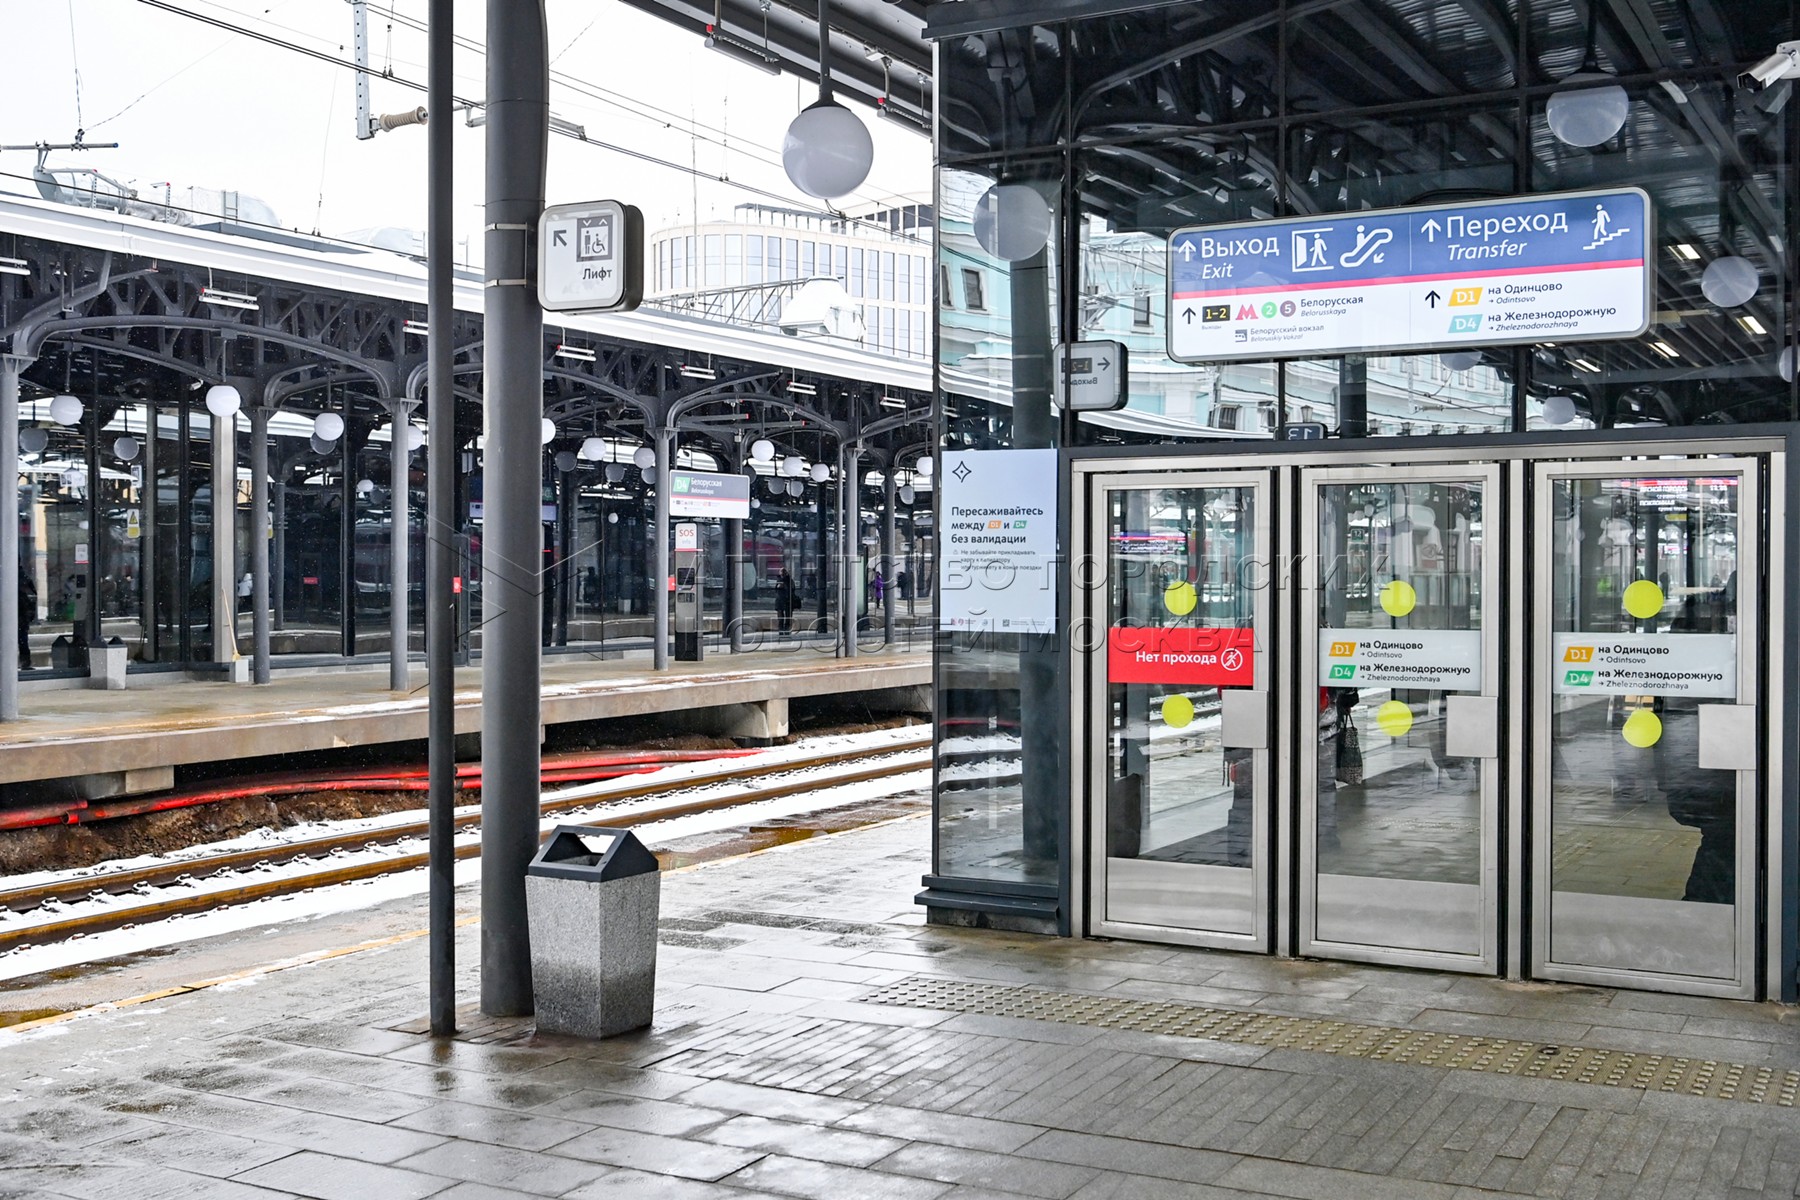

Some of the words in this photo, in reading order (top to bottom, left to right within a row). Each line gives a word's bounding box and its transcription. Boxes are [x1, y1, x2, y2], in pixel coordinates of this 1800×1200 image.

[1447, 212, 1569, 241] Переход
[1201, 237, 1279, 259] Выход
[1448, 239, 1527, 261] Transfer
[583, 267, 612, 281] Лифт
[1202, 263, 1233, 280] Exit
[1488, 286, 1501, 295] на
[1504, 282, 1563, 295] Одинцово
[1456, 290, 1475, 303] D1
[1496, 295, 1535, 304] Odintsovo
[1300, 296, 1364, 309] Белорусская
[1300, 307, 1347, 318] Belorusskaya
[1488, 314, 1501, 322] на
[1504, 306, 1616, 322] Железнодорожную
[1455, 318, 1476, 330] D4
[1496, 320, 1578, 332] Zheleznodorozhnaya
[1250, 327, 1297, 336] Белорусский
[1299, 325, 1325, 333] вокзал
[677, 479, 687, 490] D4
[951, 506, 1043, 518] Пересаживайтесь
[951, 522, 985, 531] между
[679, 529, 694, 537] SOS
[951, 534, 968, 543] без
[971, 535, 1027, 545] валидации
[1334, 644, 1351, 655] D1
[1373, 640, 1424, 651] Одинцово
[1598, 645, 1611, 654] на
[1613, 644, 1670, 656] Одинцово
[1136, 652, 1159, 663] Нет
[1163, 653, 1217, 665] прохода
[1367, 651, 1403, 659] Odintsovo
[1569, 649, 1588, 660] D1
[1606, 656, 1646, 664] Odintsovo
[1334, 667, 1351, 677] D4
[1360, 664, 1371, 672] на
[1373, 663, 1471, 675] Железнодорожную
[1367, 674, 1440, 683] Zheleznodorozhnaya
[1569, 673, 1590, 684] D4
[1598, 670, 1611, 678] на
[1613, 669, 1723, 681] Железнодорожную
[1606, 681, 1689, 691] Zheleznodorozhnaya
